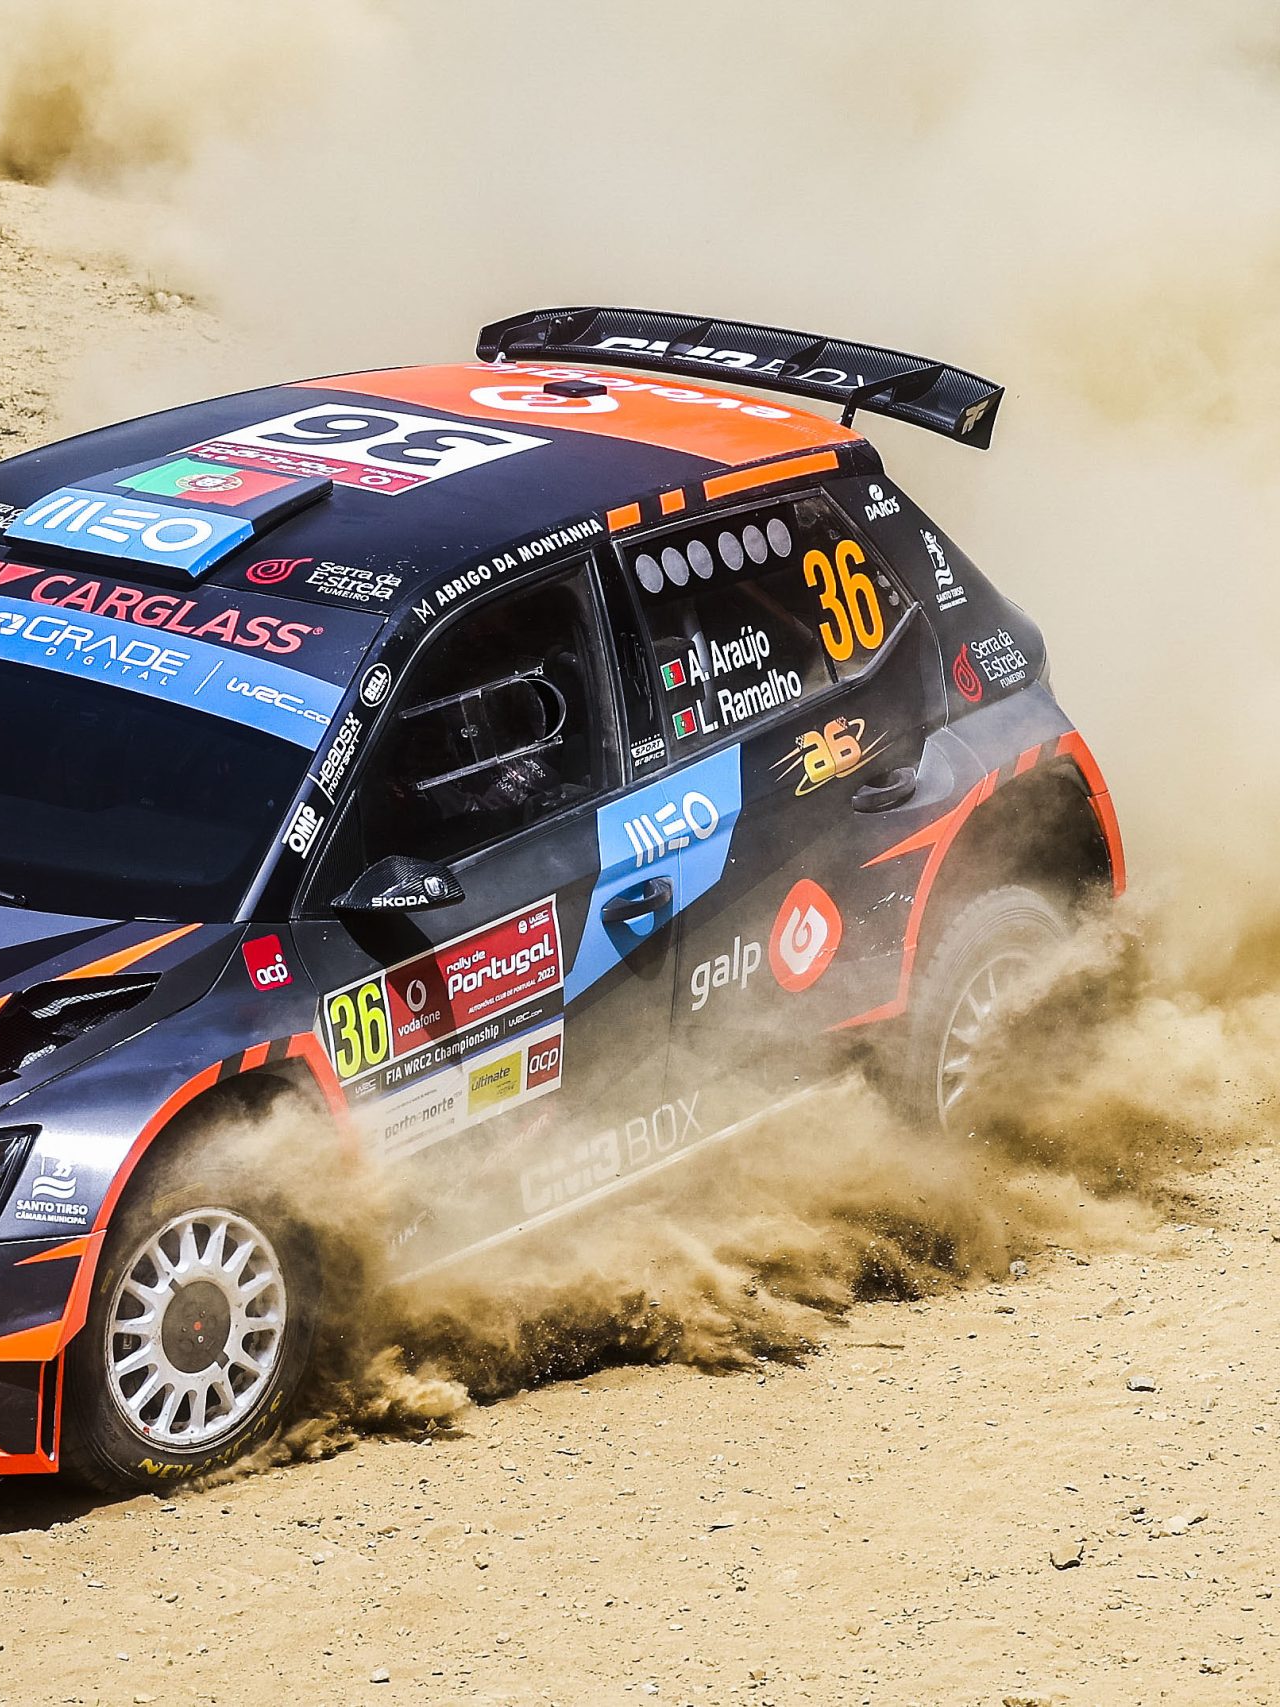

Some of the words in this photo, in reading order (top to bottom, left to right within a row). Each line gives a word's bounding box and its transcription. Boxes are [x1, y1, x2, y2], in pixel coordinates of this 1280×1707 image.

[257, 414, 511, 466] 36
[23, 496, 213, 552] MEO
[316, 561, 370, 580] Serra
[375, 572, 402, 587] da
[435, 565, 492, 606] ABRIGO
[492, 553, 518, 573] DA
[517, 518, 604, 563] MONTANHA
[305, 571, 394, 600] Estrela
[317, 586, 370, 602] FUMEIRO
[803, 539, 884, 661] 36
[687, 650, 710, 686] A.
[711, 625, 770, 677] Araújo
[970, 634, 999, 659] Serra
[997, 628, 1015, 648] da
[45, 647, 169, 686] DIGITAL
[980, 647, 1028, 681] Estrela
[363, 669, 388, 702] BELL
[697, 699, 719, 735] L.
[718, 669, 802, 726] Ramalho
[634, 740, 662, 757] SPORT
[289, 805, 317, 853] OMP
[623, 791, 720, 868] MEO
[256, 961, 288, 985] acp
[447, 956, 470, 974] rally
[471, 951, 486, 963] de
[448, 934, 554, 1000] Portugal
[537, 965, 556, 983] 2023
[690, 935, 761, 1011] galp
[329, 982, 388, 1079] 36
[398, 1010, 441, 1037] vodafone
[386, 1068, 403, 1086] FIA
[404, 1053, 432, 1075] WRC2
[435, 1024, 500, 1063] Championship
[529, 1047, 559, 1074] acp
[15, 1211, 47, 1222] CÂMARA
[47, 1214, 87, 1225] MUNICIPAL
[16, 1199, 55, 1213] SANTO
[55, 1203, 88, 1215] TIRSO
